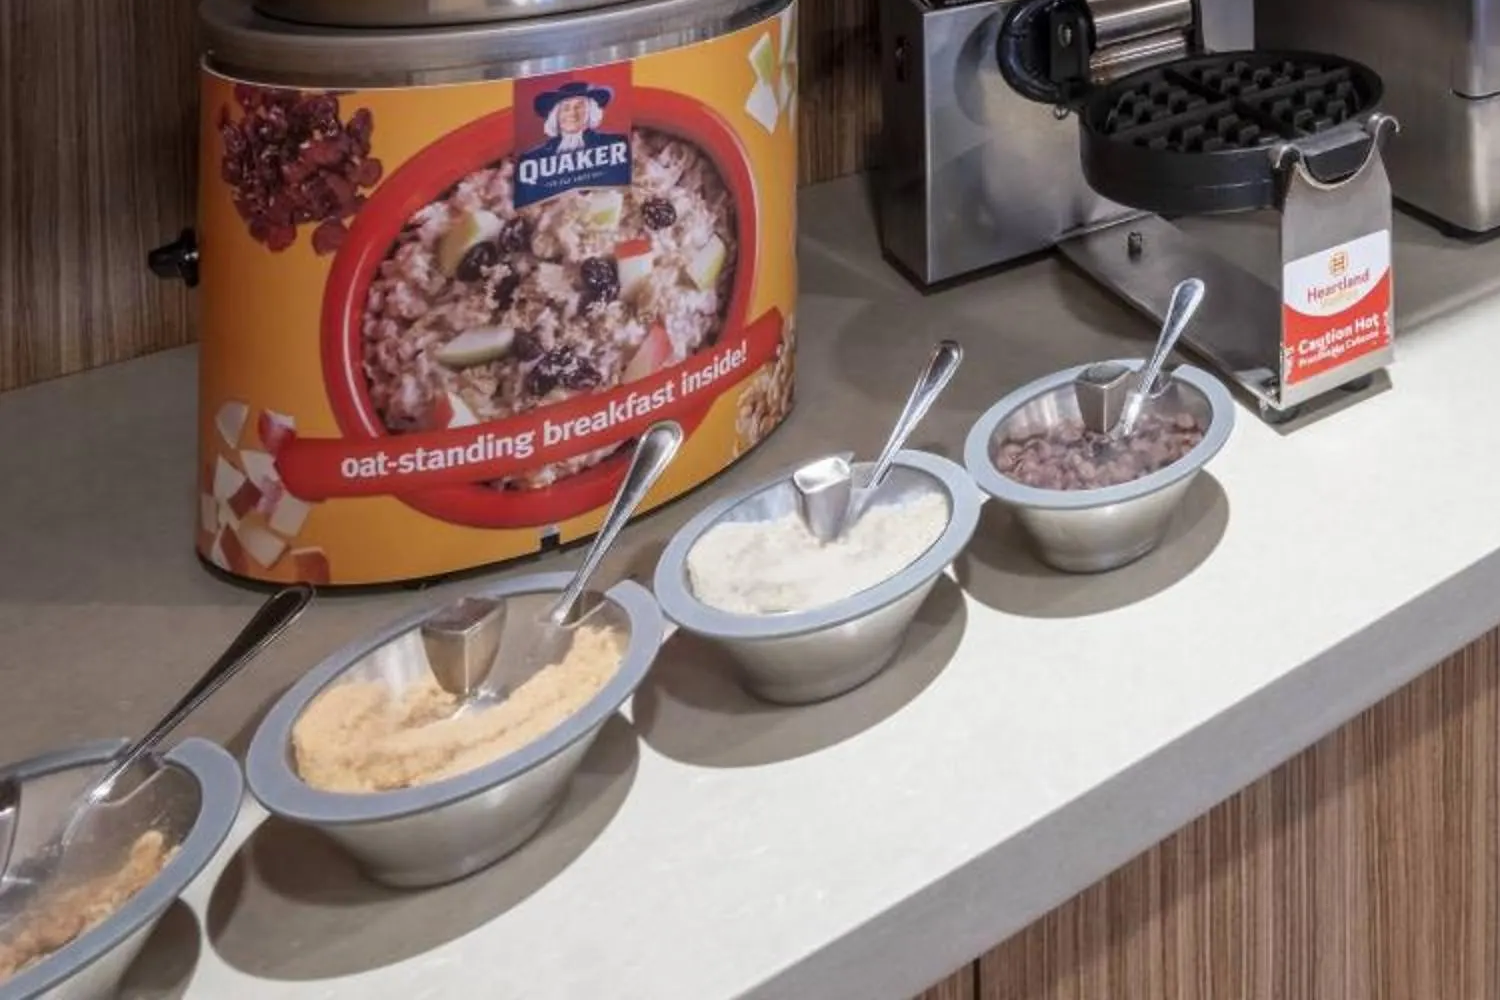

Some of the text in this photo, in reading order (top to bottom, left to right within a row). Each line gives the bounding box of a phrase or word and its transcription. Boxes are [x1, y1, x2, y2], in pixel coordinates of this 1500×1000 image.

[519, 141, 627, 185] QUAKER
[1307, 267, 1370, 303] Heartland
[1299, 326, 1353, 354] Caution
[1355, 313, 1379, 333] Hot
[341, 341, 748, 479] oat-standing breakfast inside!
